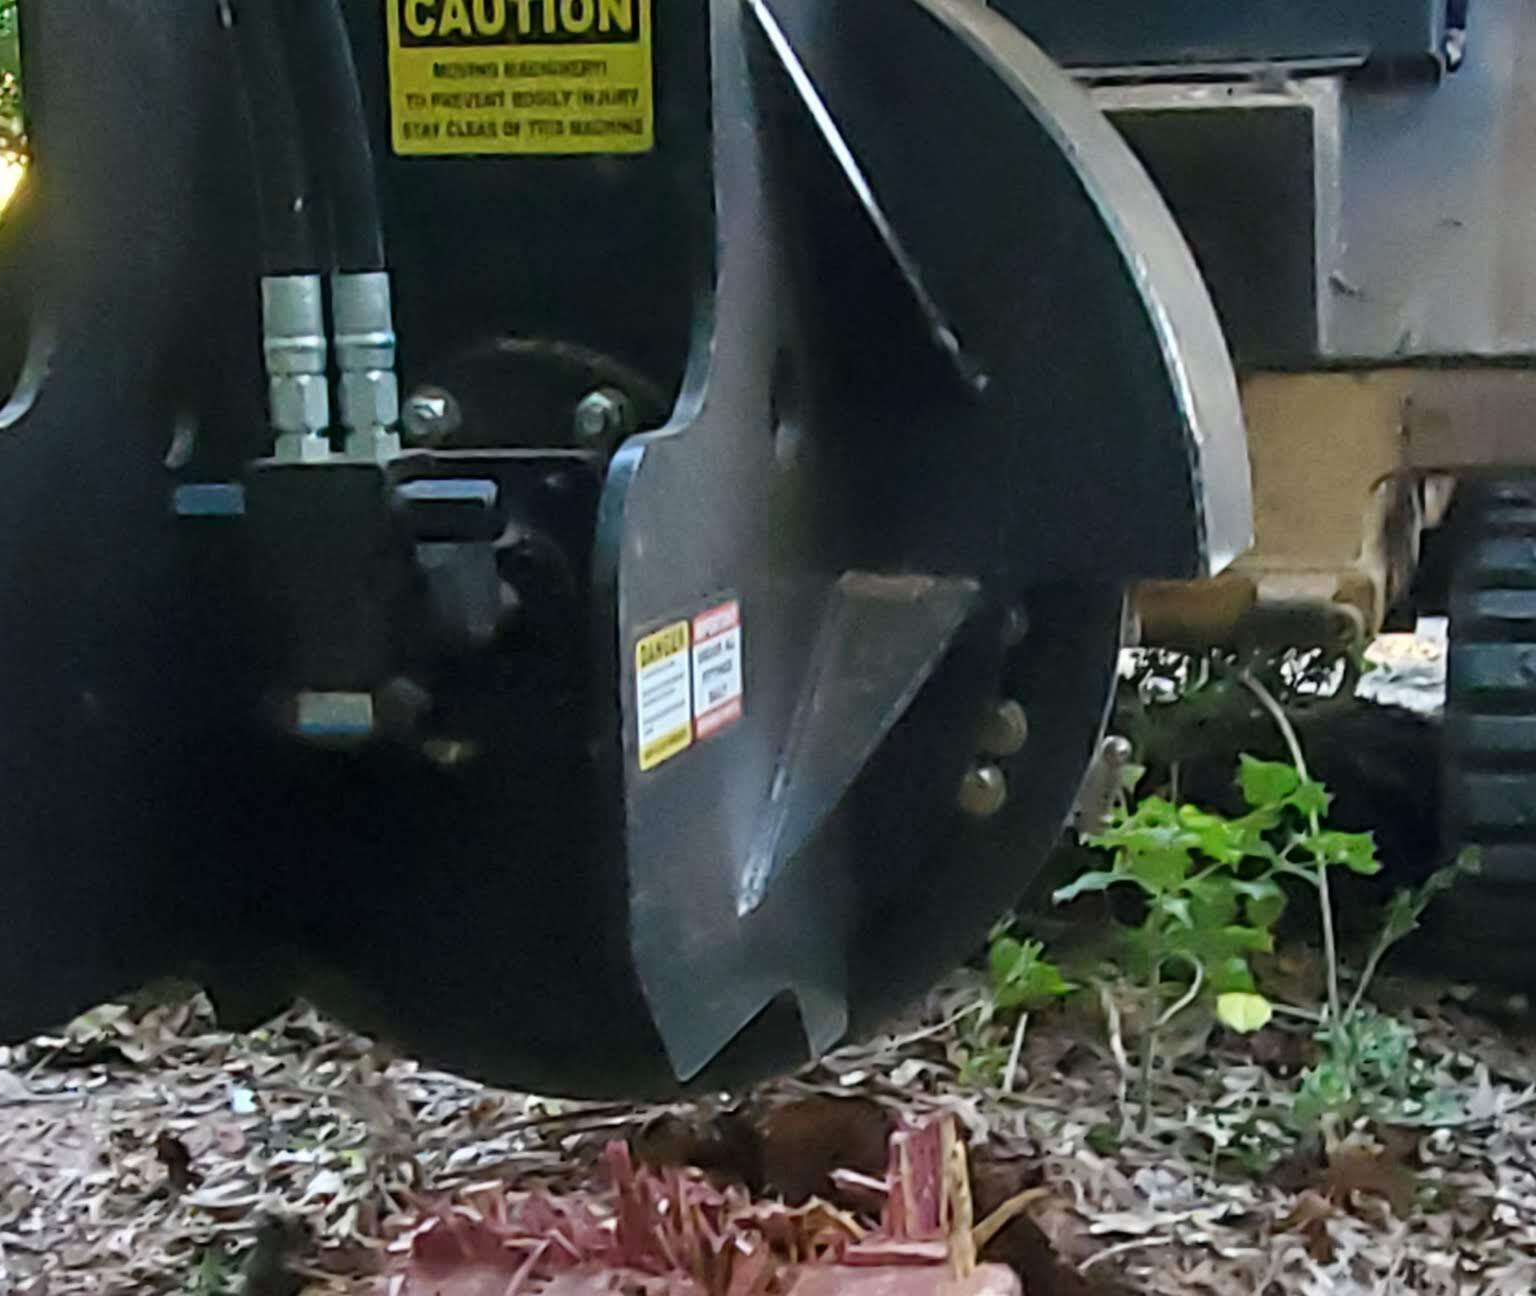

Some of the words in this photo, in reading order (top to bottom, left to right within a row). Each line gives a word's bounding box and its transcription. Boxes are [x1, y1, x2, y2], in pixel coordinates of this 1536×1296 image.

[406, 0, 633, 37] CAUTION
[406, 93, 427, 108] TO
[432, 91, 505, 108] PREVENT
[512, 90, 573, 108] BODILY
[580, 88, 638, 107] INJURY
[403, 121, 439, 139] STAY
[446, 120, 498, 138] CLEAR
[503, 120, 521, 137] OF
[528, 118, 564, 136] THIS
[569, 117, 642, 136] MACHINE
